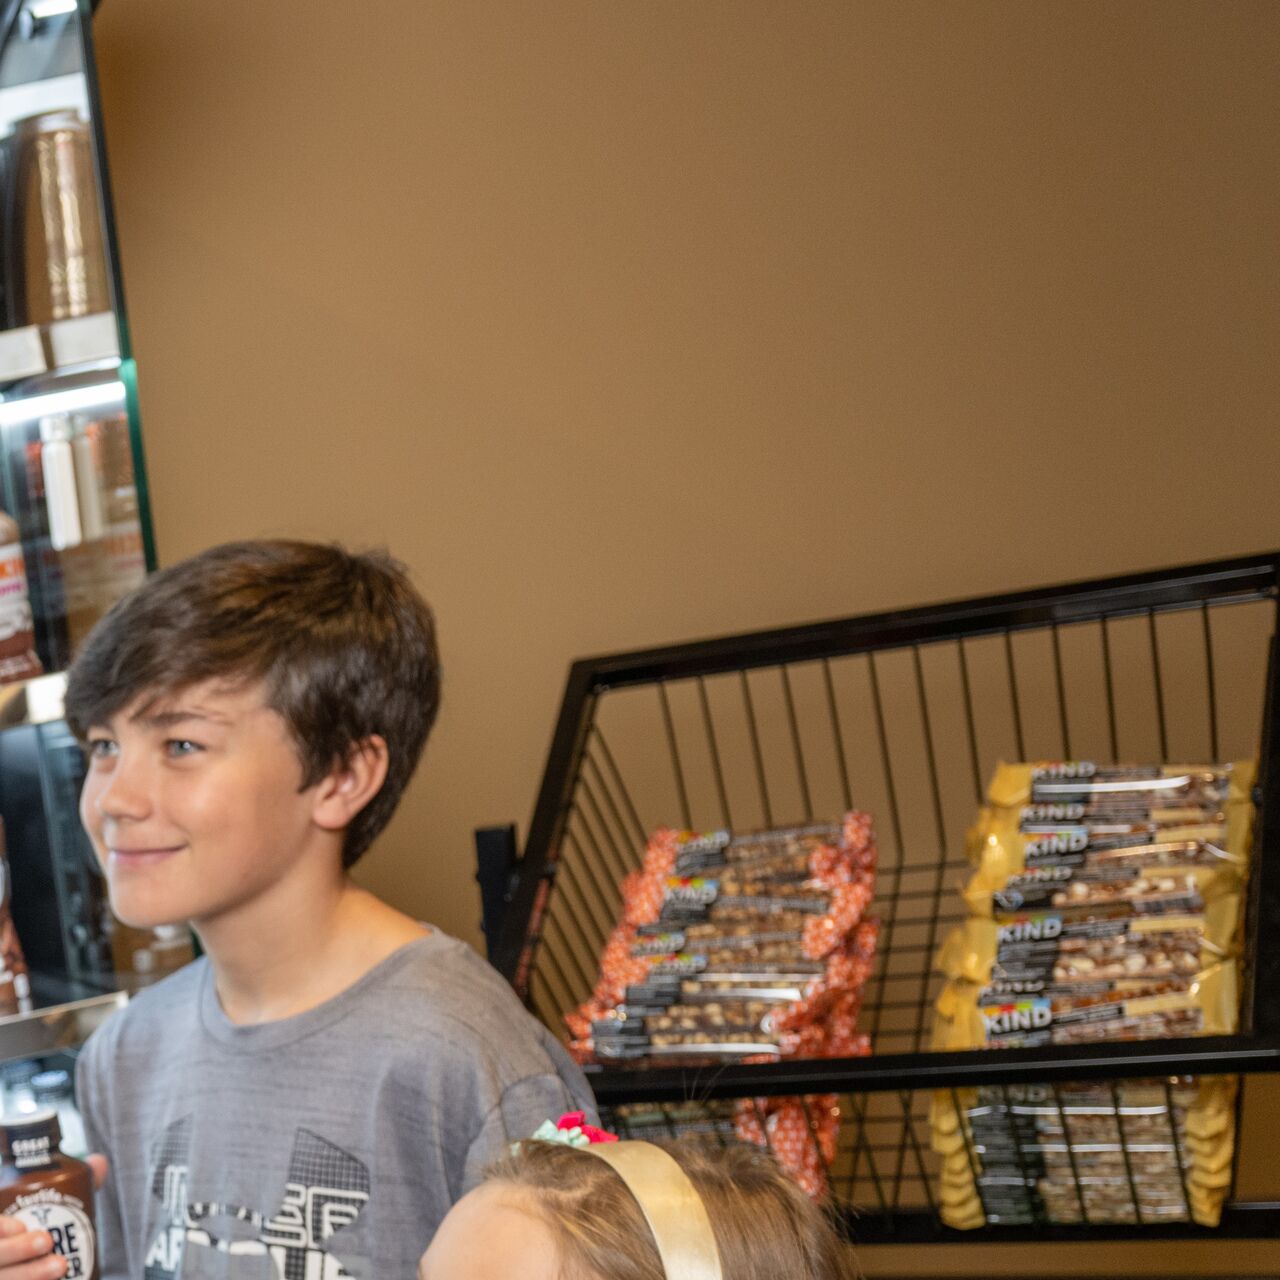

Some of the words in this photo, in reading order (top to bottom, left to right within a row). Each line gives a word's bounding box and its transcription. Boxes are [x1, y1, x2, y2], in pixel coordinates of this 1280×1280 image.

[1025, 833, 1088, 857] KIND
[998, 919, 1062, 941] KIND
[986, 1006, 1052, 1033] KIND
[48, 1222, 79, 1254] RE
